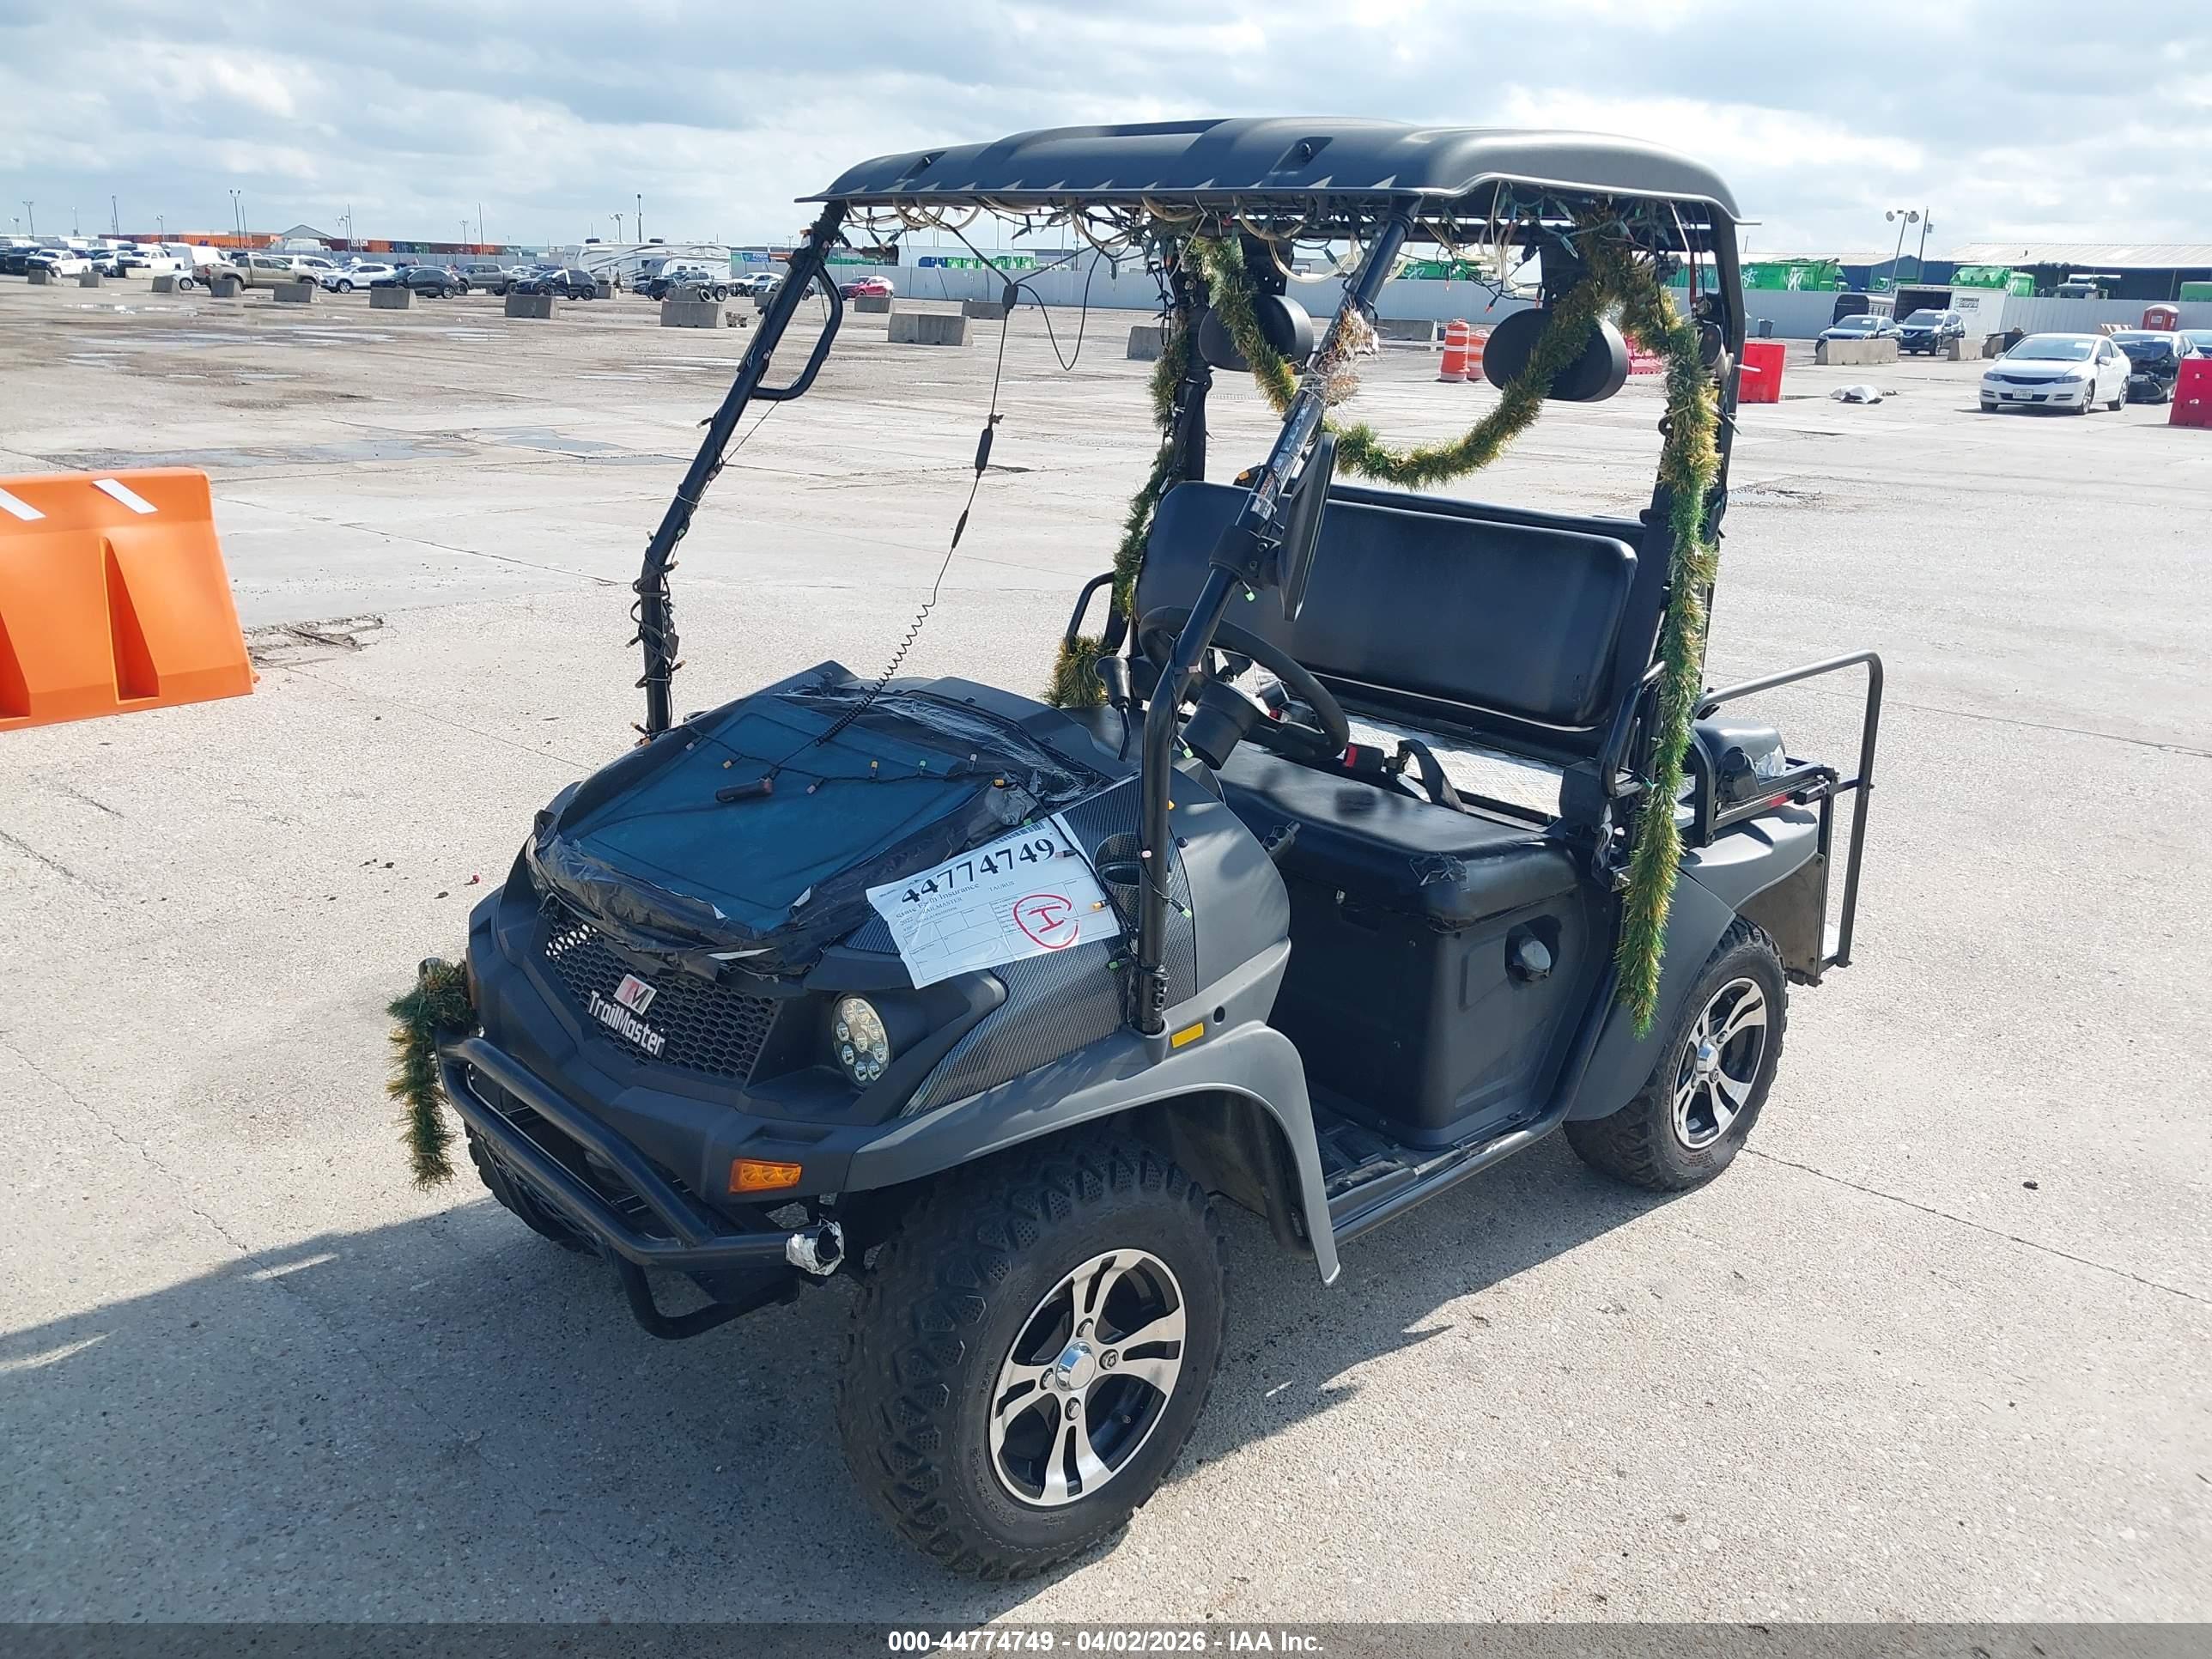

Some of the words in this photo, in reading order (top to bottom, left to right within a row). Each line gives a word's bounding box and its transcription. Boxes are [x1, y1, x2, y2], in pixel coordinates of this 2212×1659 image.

[901, 837, 1055, 903] 44774749
[939, 883, 980, 900] Insurance
[899, 916, 914, 927] 2022
[988, 879, 1016, 892] TAURUS
[587, 989, 665, 1055] TrailMaster
